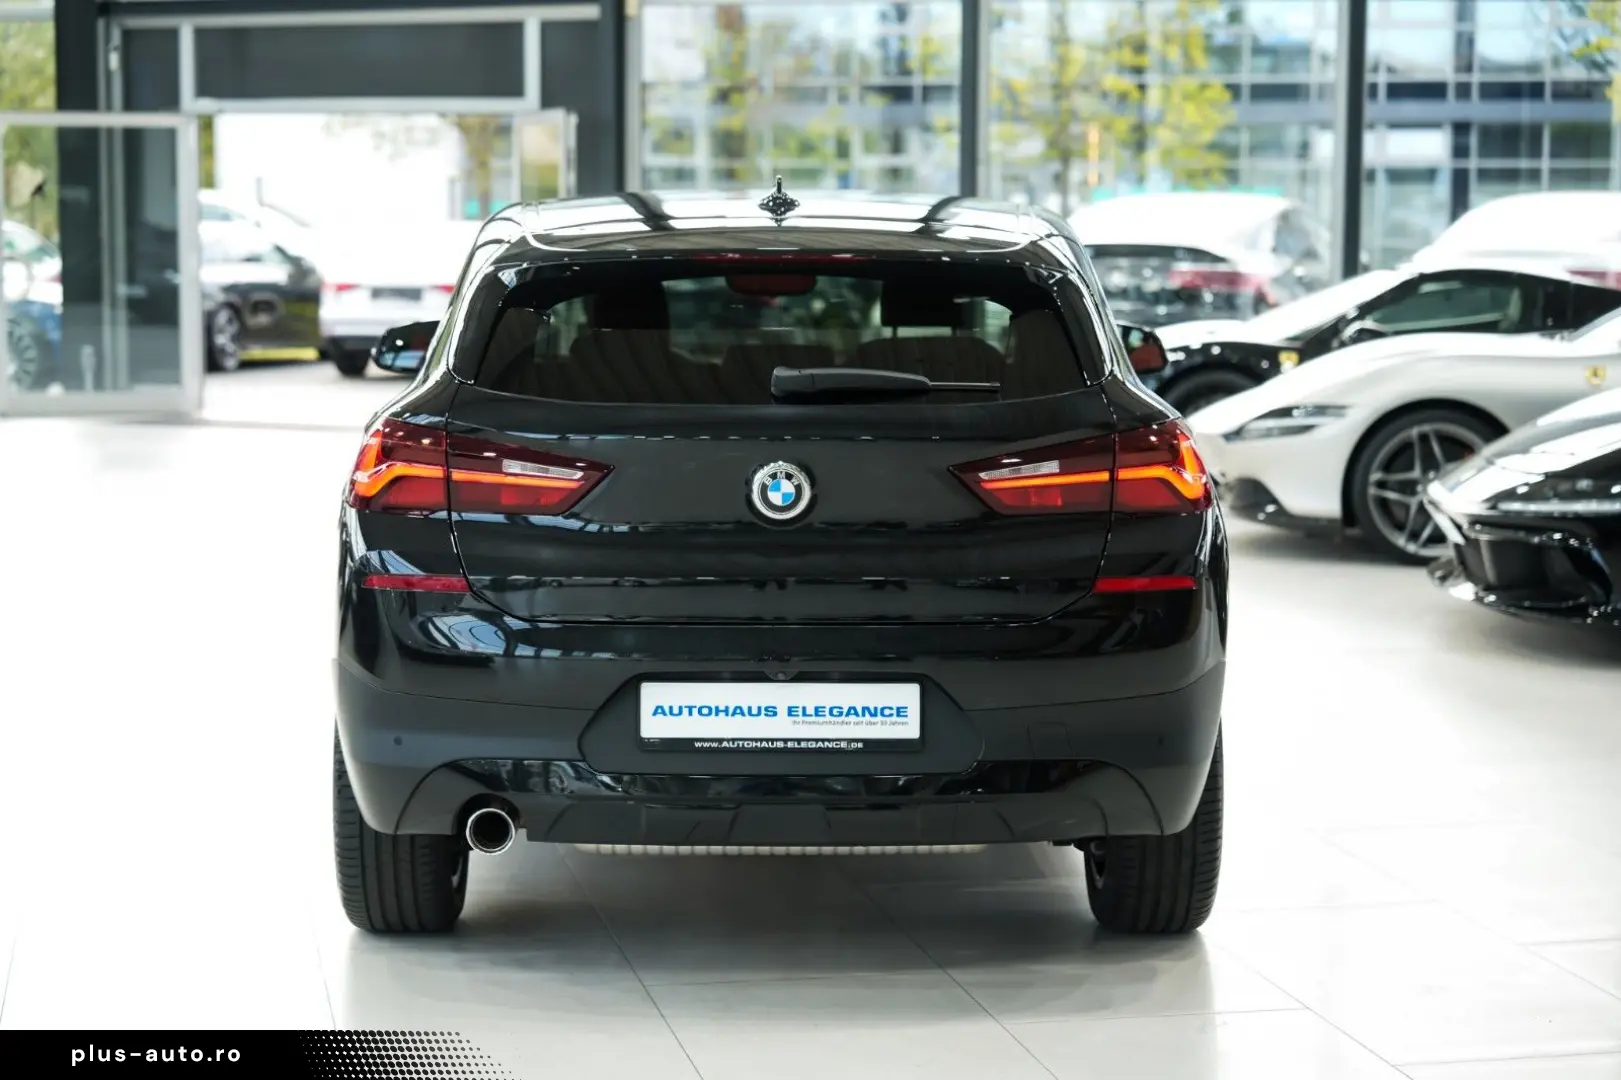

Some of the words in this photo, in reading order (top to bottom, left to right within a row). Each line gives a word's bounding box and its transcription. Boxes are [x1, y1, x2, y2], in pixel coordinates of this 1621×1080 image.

[764, 471, 800, 486] BMW
[651, 705, 778, 718] AUTOHAUS
[787, 705, 909, 718] ELEGANCE
